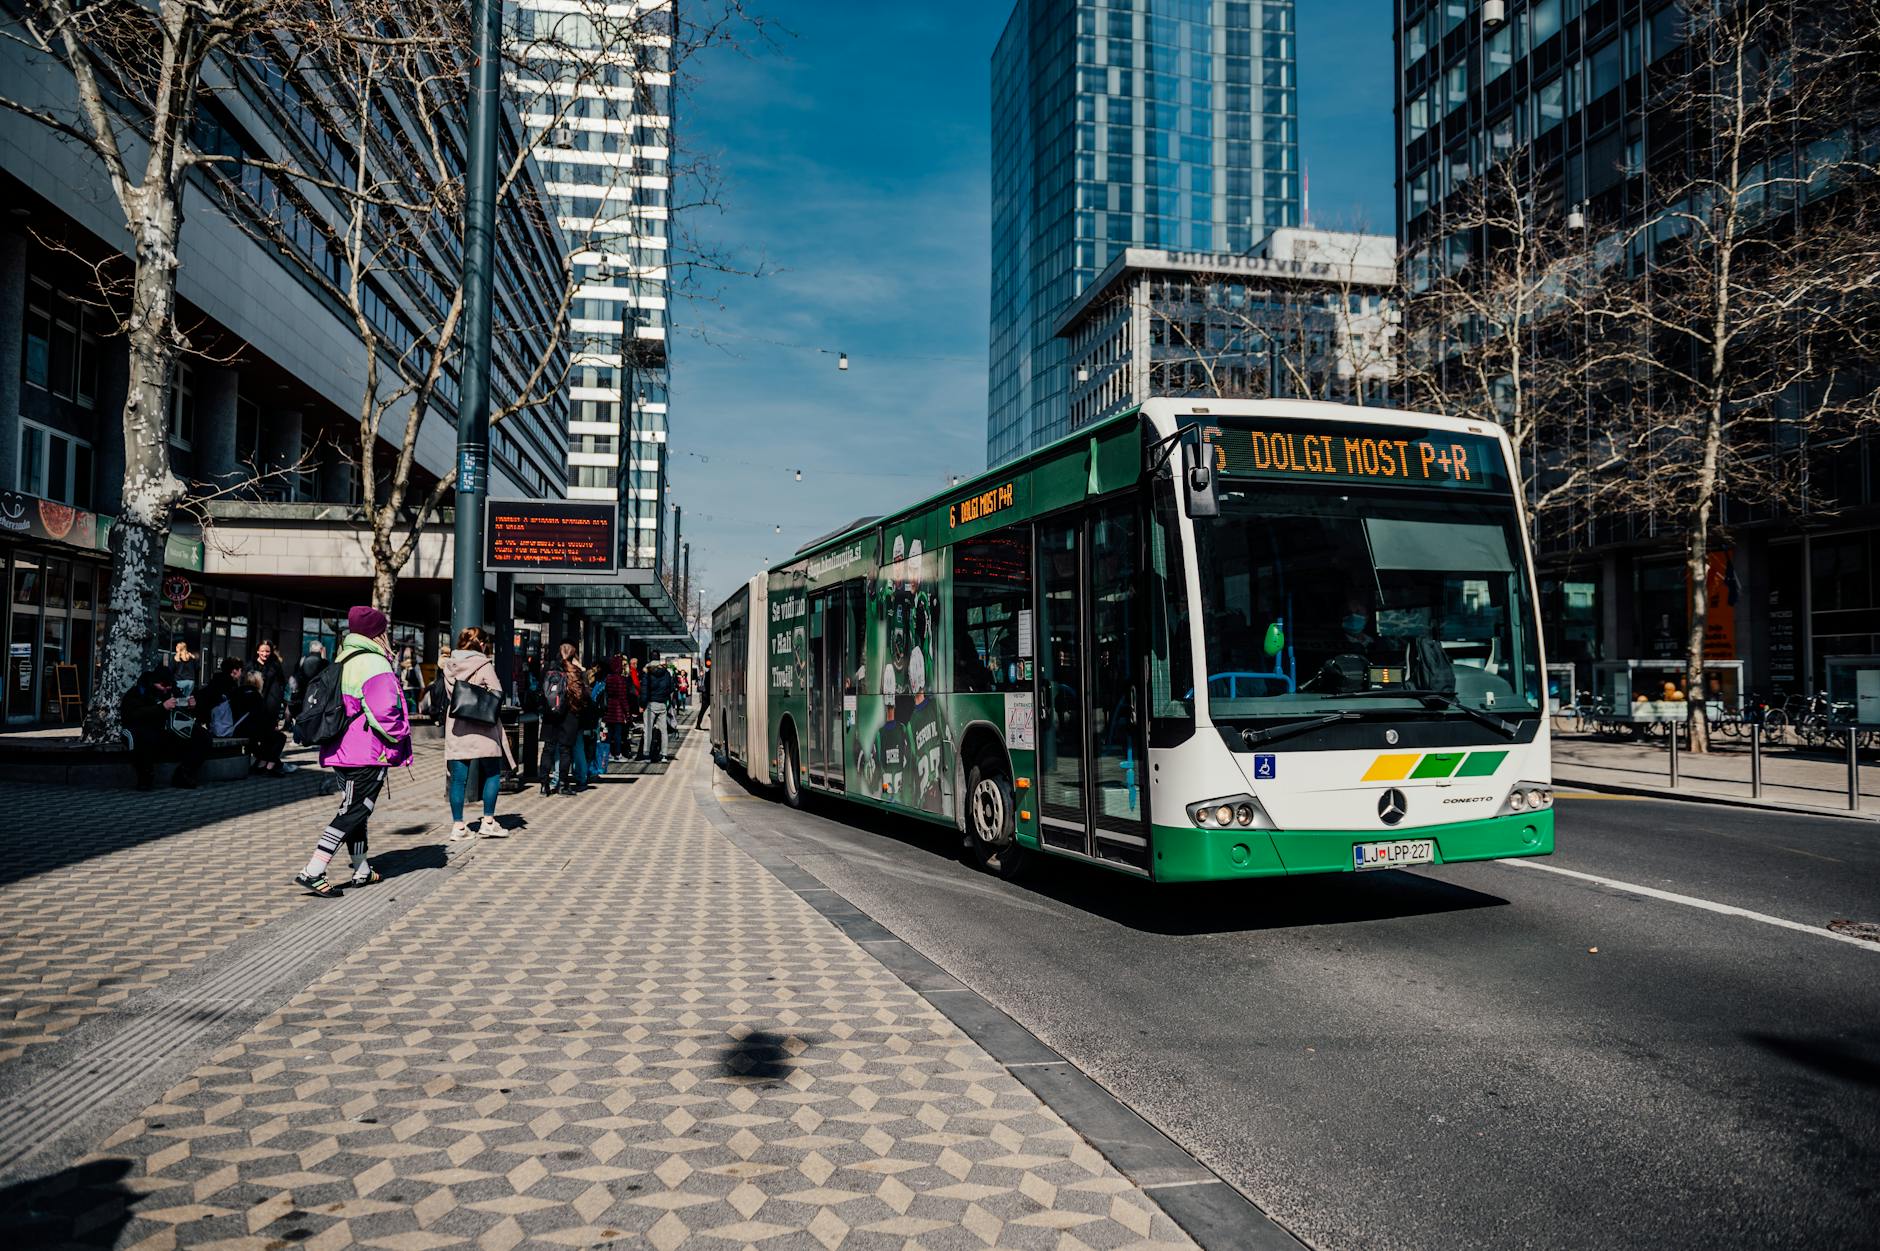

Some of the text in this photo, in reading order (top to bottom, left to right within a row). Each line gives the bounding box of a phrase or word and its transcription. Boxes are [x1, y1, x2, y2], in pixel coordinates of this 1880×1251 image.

[1252, 431, 1337, 473] DOLGI
[1344, 436, 1409, 477] MOST
[1418, 442, 1471, 481] P+R
[949, 483, 1013, 529] 6 DOLGI MOST P+R
[772, 595, 806, 622] Se vidimo
[771, 631, 792, 655] v Hali
[772, 665, 793, 688] Tivoli!
[1443, 796, 1493, 804] CONECTO
[1363, 847, 1379, 863] LJ
